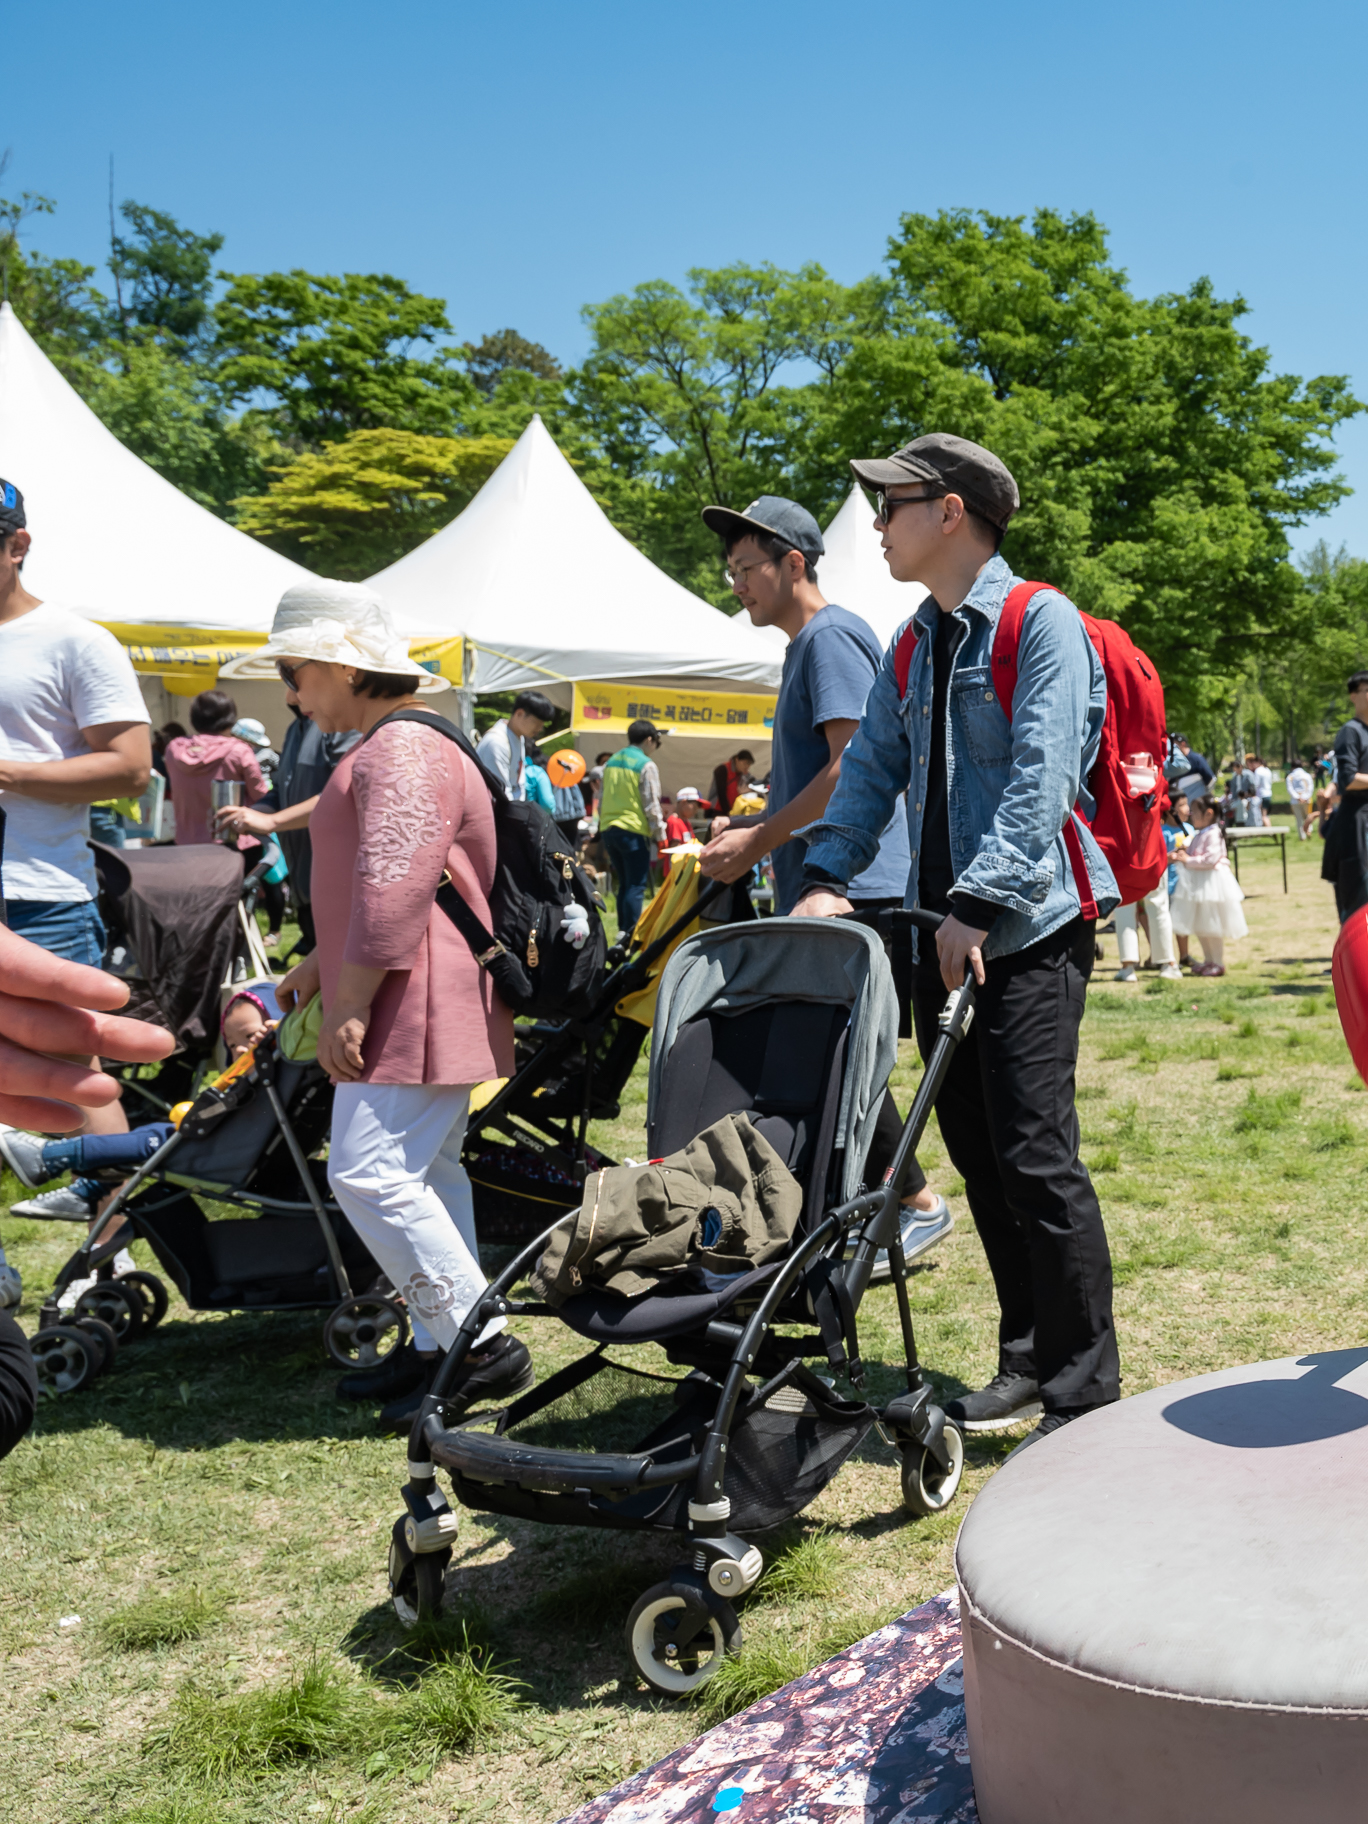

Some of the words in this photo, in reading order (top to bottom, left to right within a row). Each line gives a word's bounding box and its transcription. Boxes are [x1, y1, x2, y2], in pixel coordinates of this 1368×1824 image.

[627, 702, 661, 720] 올해는
[664, 704, 676, 720] 꼭
[726, 708, 748, 724] 담배
